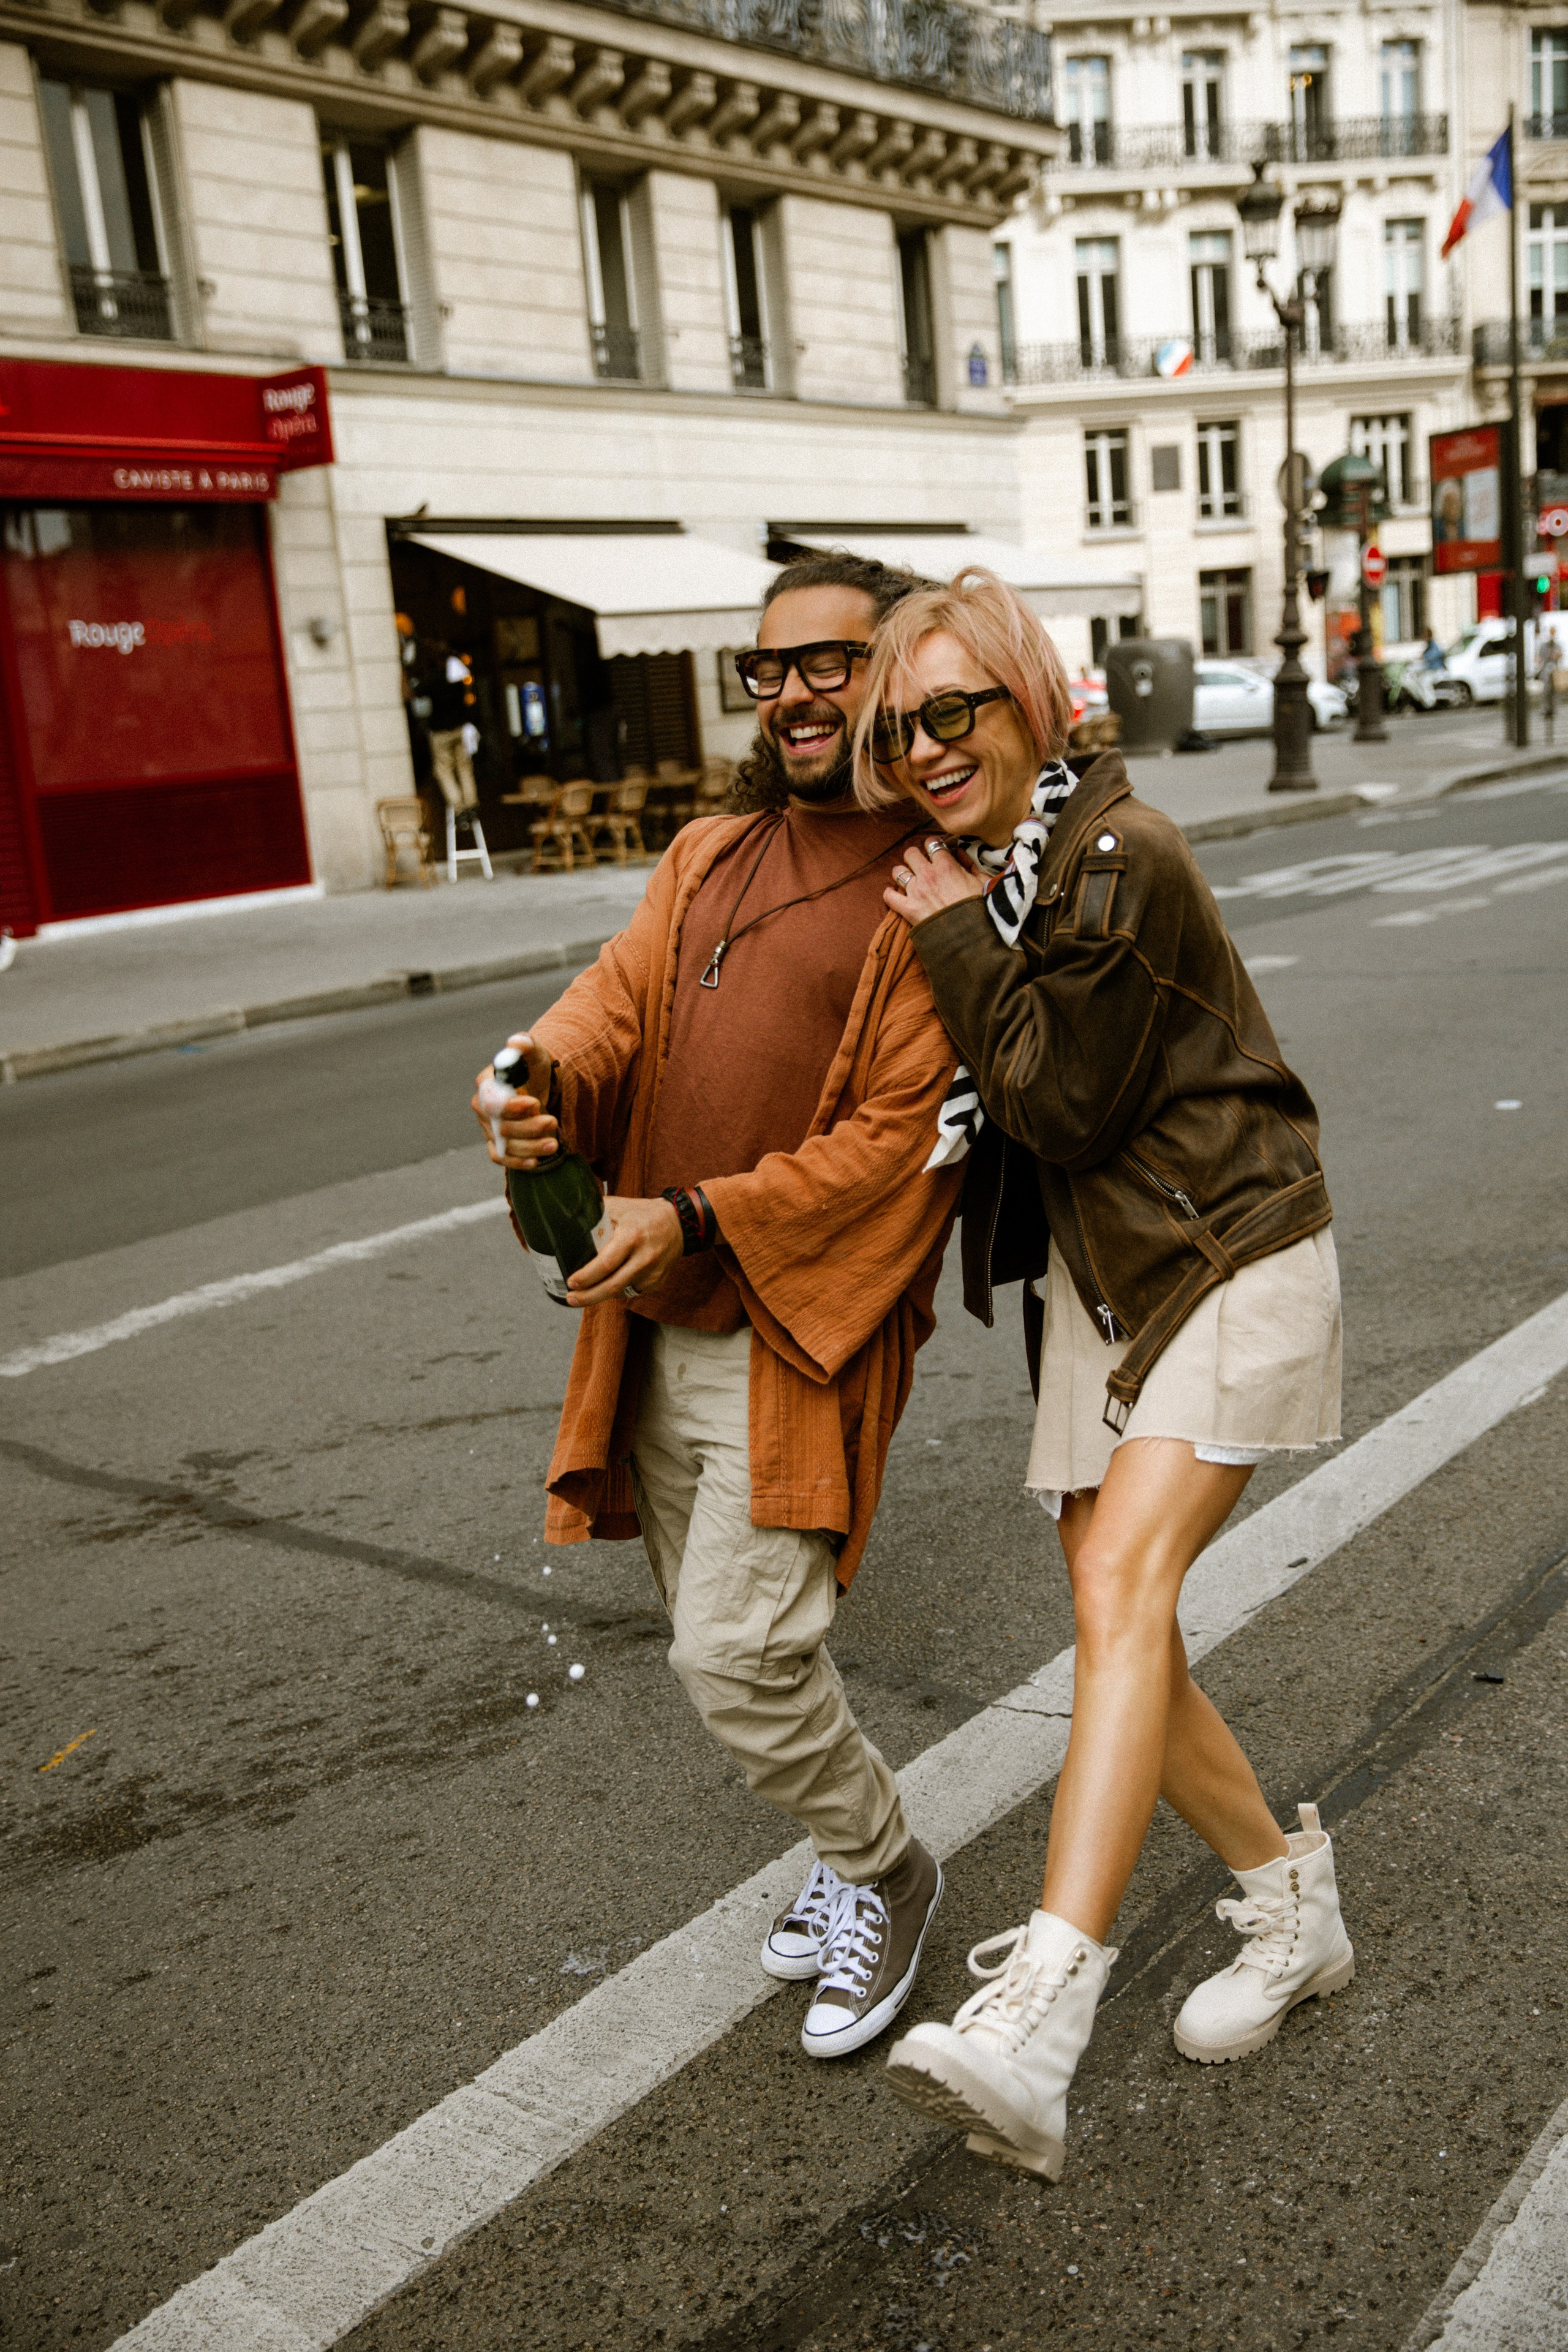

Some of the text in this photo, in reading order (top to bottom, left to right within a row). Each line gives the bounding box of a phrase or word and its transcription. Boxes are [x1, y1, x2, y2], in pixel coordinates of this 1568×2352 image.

[263, 383, 316, 414] Rouge
[114, 468, 194, 490] CAVISTE
[217, 471, 270, 492] PARIS
[69, 619, 146, 655] Rouge
